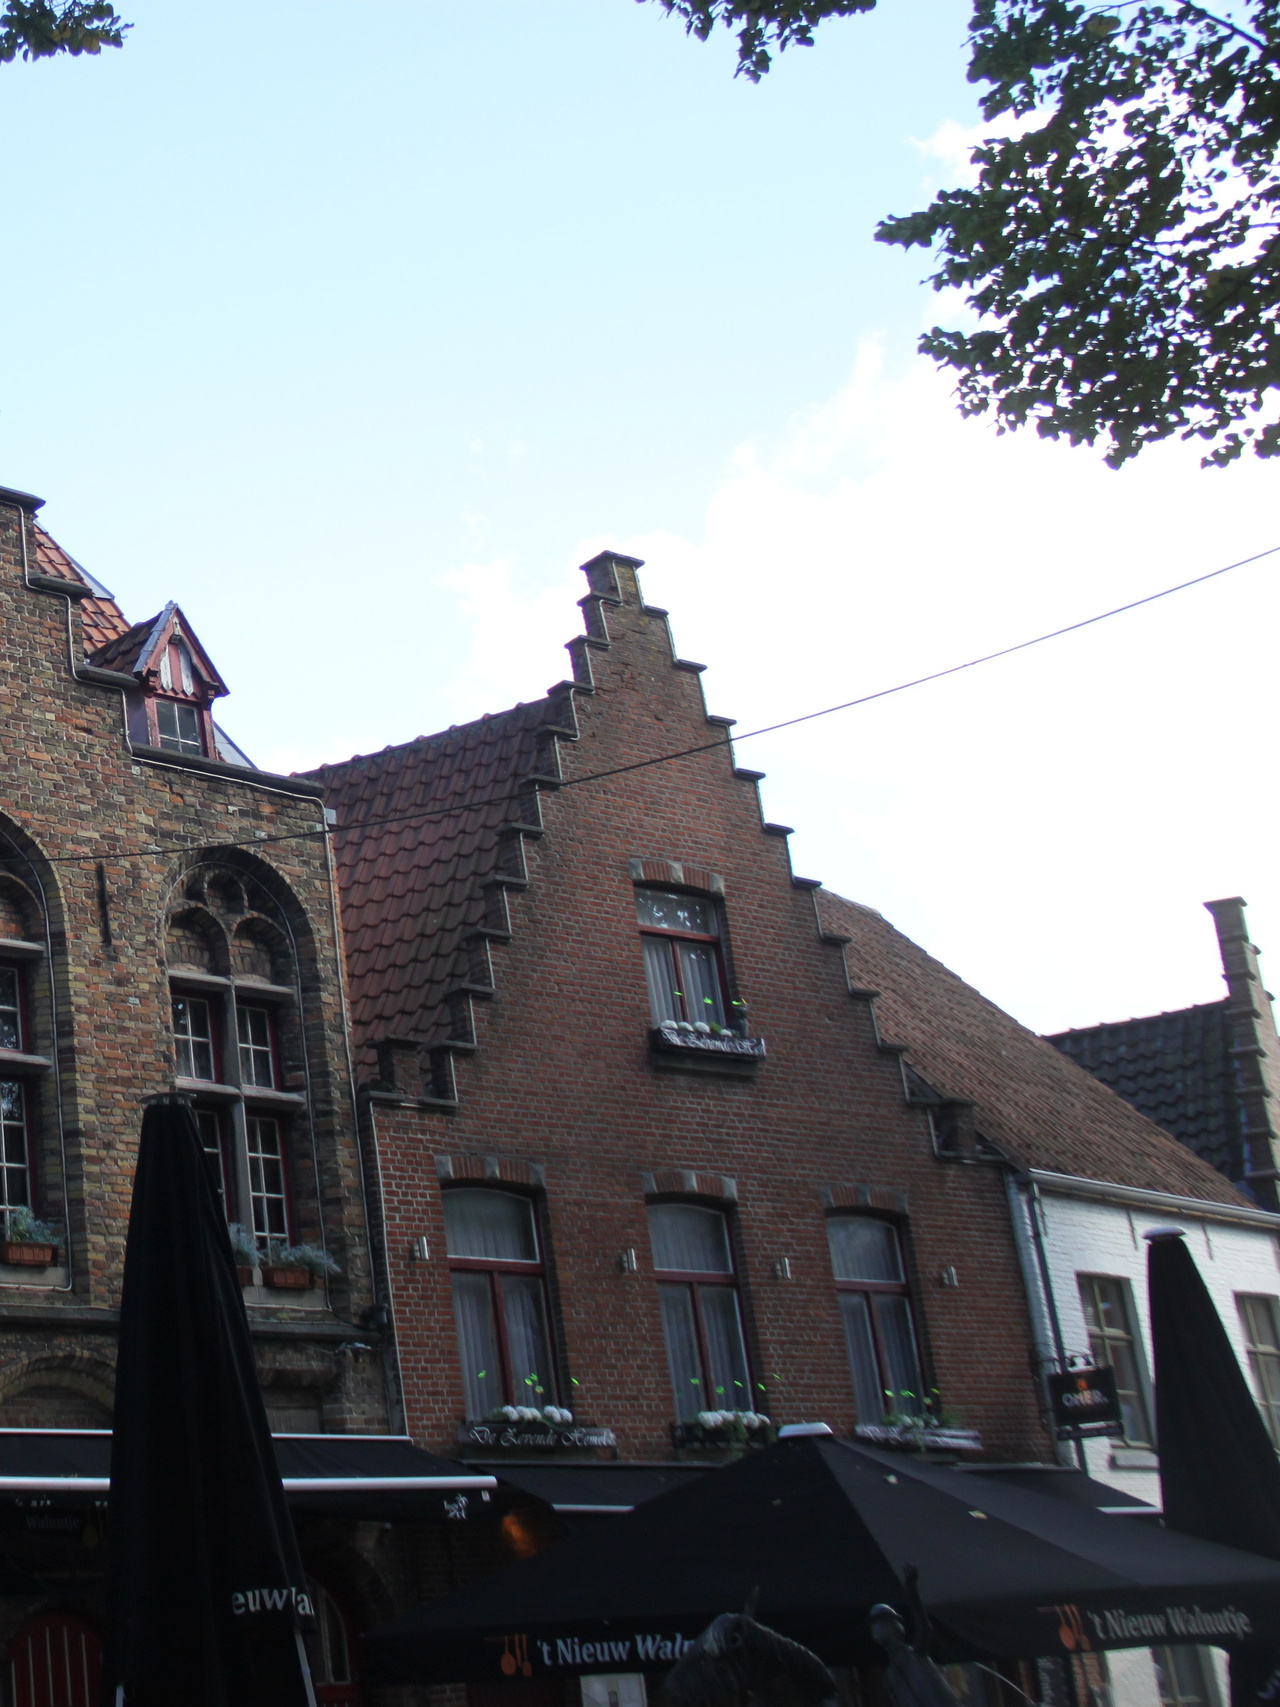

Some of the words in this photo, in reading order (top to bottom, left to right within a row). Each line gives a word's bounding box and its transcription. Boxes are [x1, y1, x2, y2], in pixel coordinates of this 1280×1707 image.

[470, 1426, 497, 1445] De
[1086, 1609, 1107, 1641] 't
[1104, 1608, 1168, 1640] Nieuw
[1166, 1605, 1253, 1641] Walnutje
[536, 1639, 553, 1666] 't
[556, 1637, 631, 1665] Nieuw
